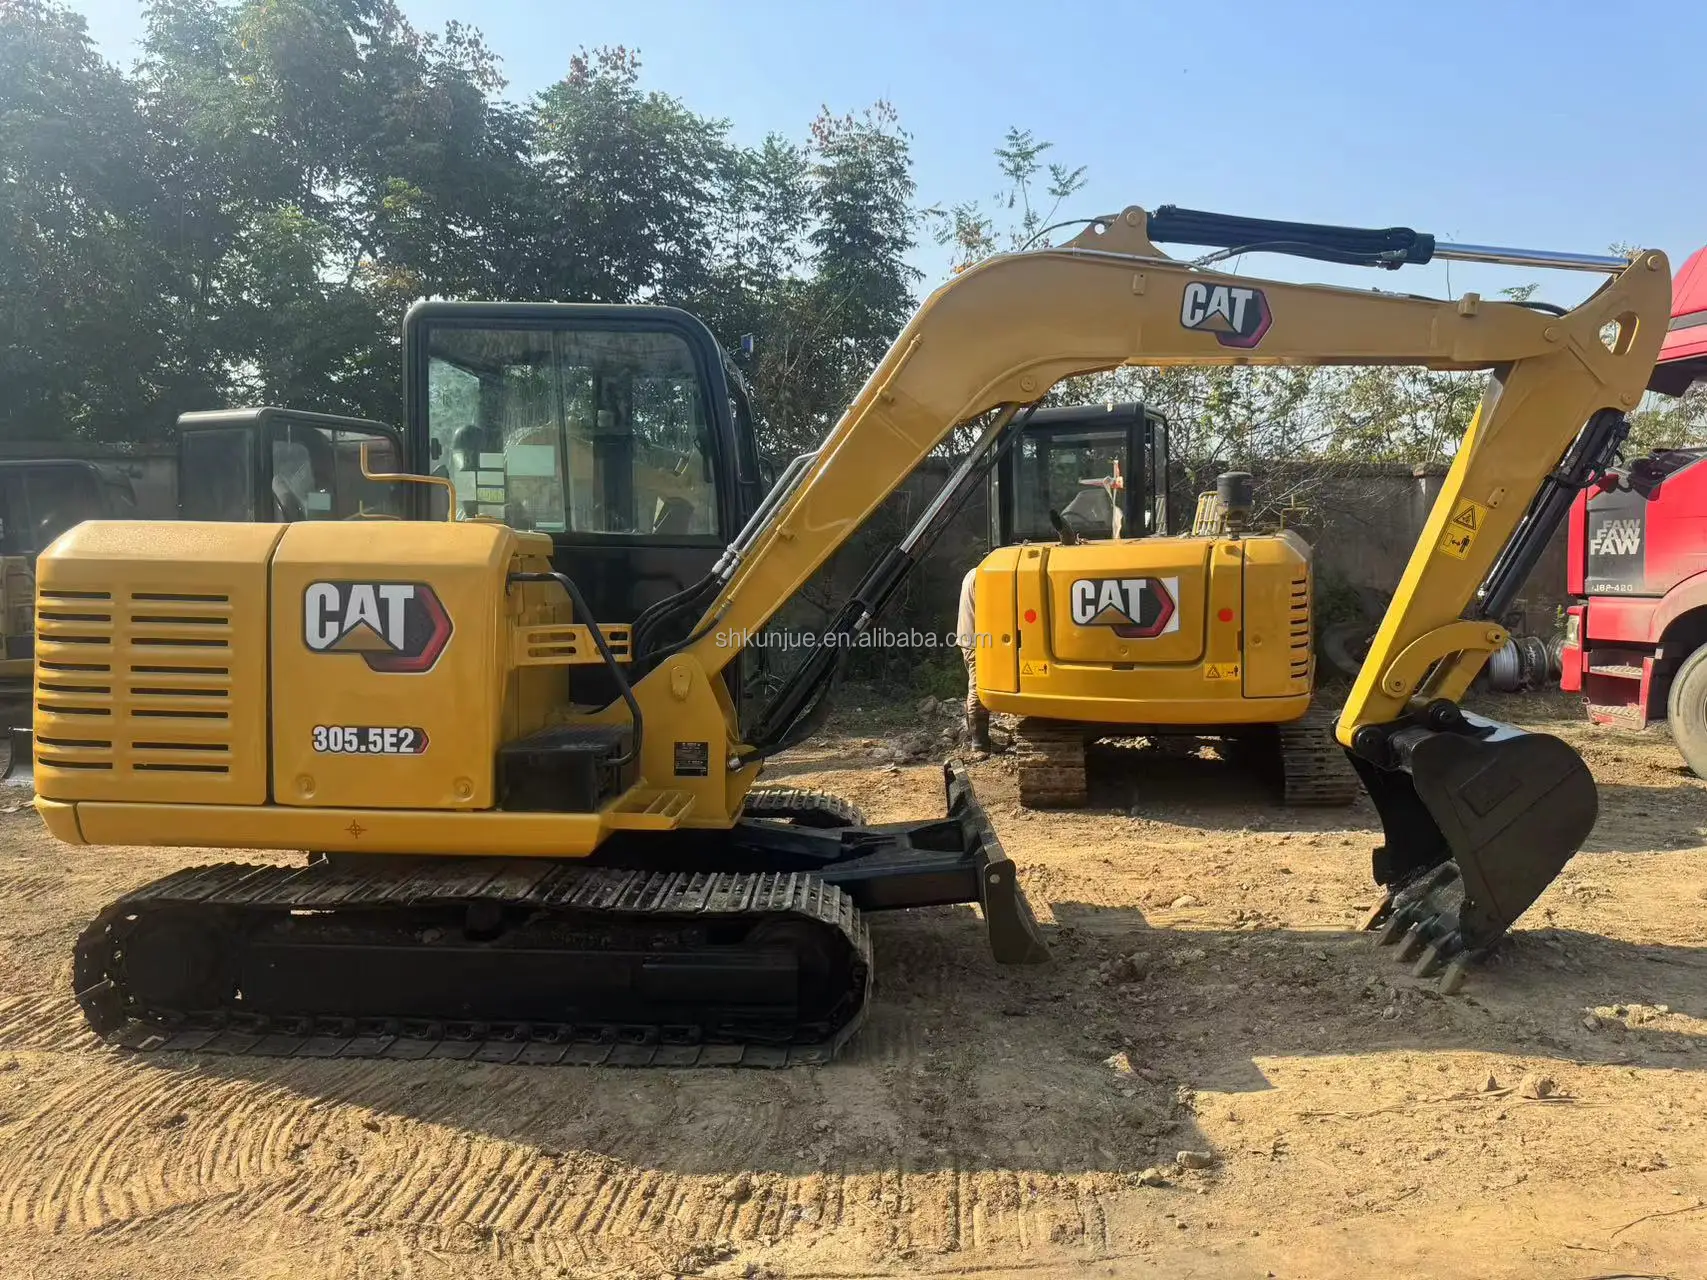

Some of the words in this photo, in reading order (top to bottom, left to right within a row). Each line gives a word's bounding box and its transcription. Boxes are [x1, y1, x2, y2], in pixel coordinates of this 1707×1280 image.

[1181, 282, 1253, 334] CAT
[1596, 528, 1640, 542] FAW
[1603, 519, 1640, 531] FAW
[1590, 538, 1640, 555] FAW
[1072, 579, 1147, 624] CAT
[305, 583, 414, 650] CAT
[313, 726, 414, 753] 305.5E2
